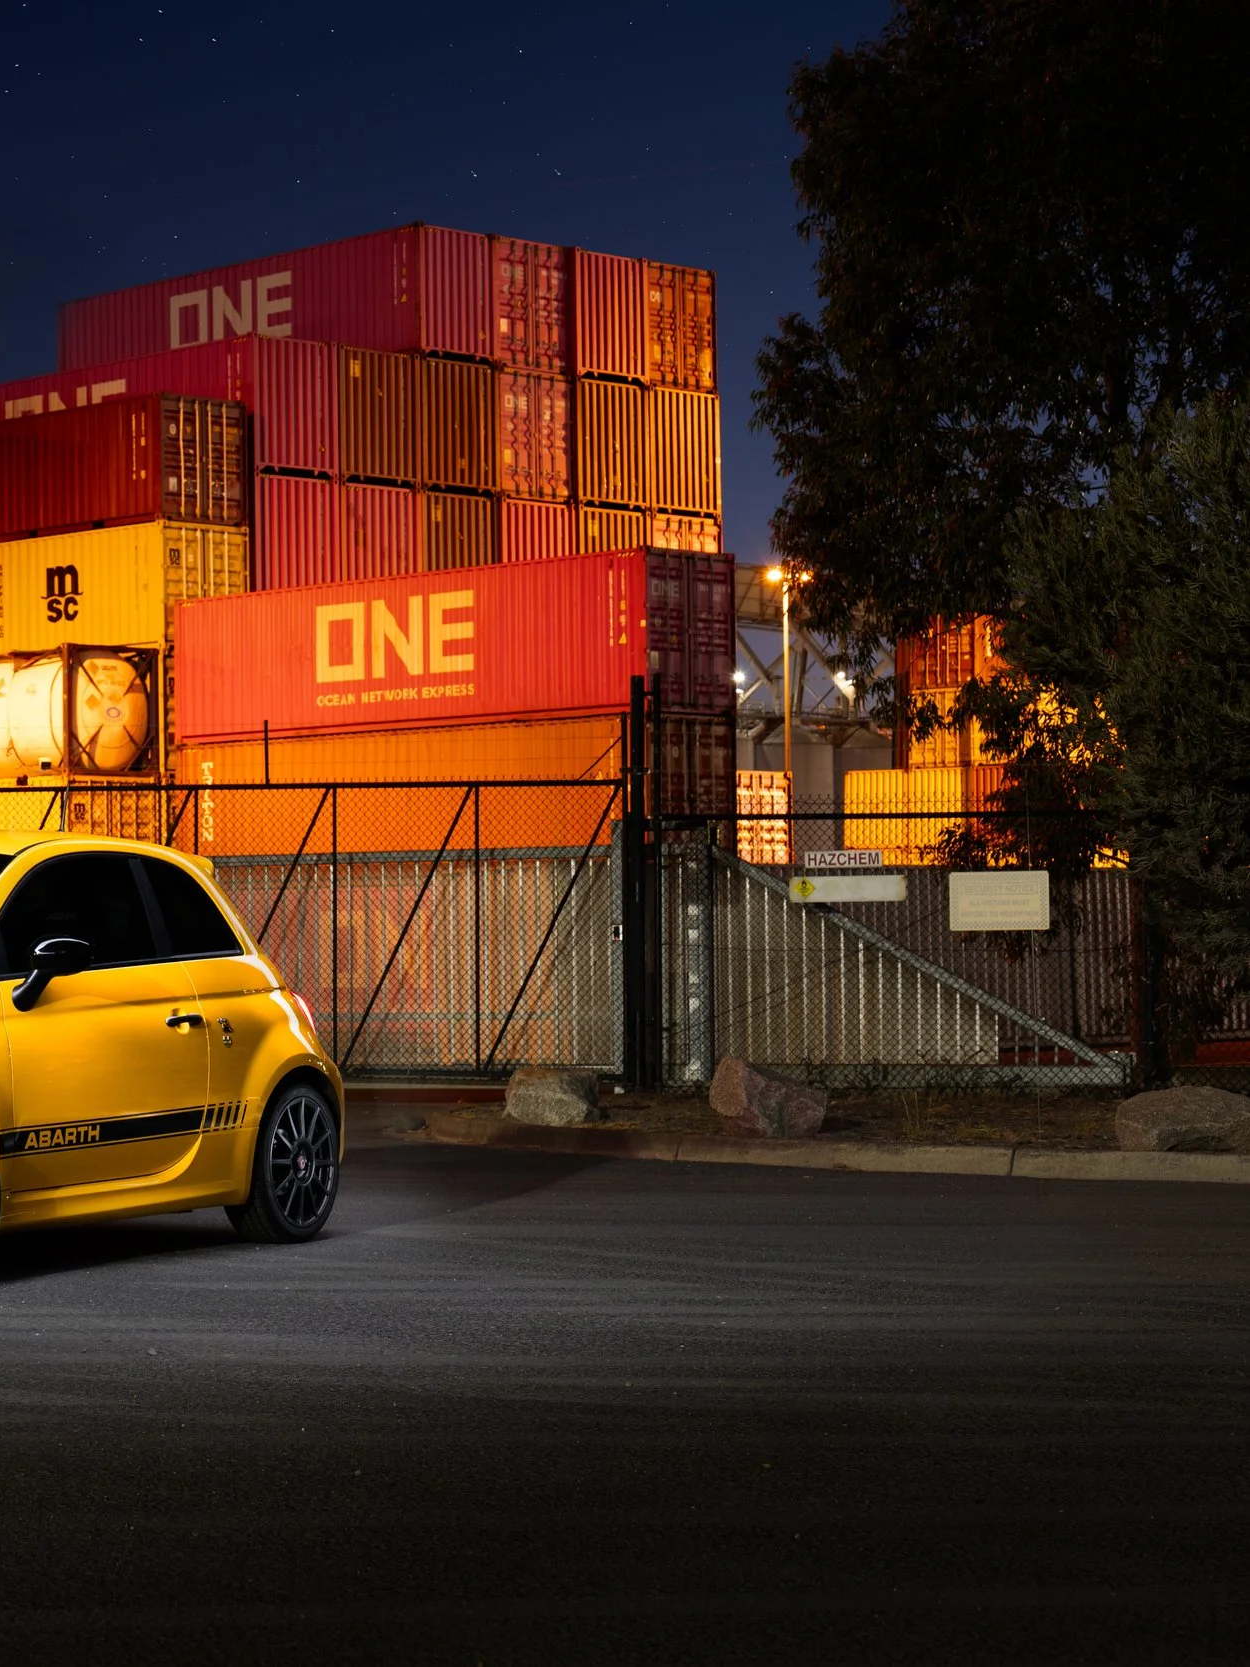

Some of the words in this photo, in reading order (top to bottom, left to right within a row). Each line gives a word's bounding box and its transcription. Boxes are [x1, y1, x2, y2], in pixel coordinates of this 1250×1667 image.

[170, 270, 292, 350] ONE
[651, 579, 680, 597] ONE
[316, 589, 474, 684] ONE
[316, 693, 356, 707] OCEAN
[361, 687, 419, 704] NETWORK
[421, 683, 475, 699] EXPRESS
[807, 852, 880, 867] HAZCHEM
[24, 1124, 100, 1150] ABARTH
